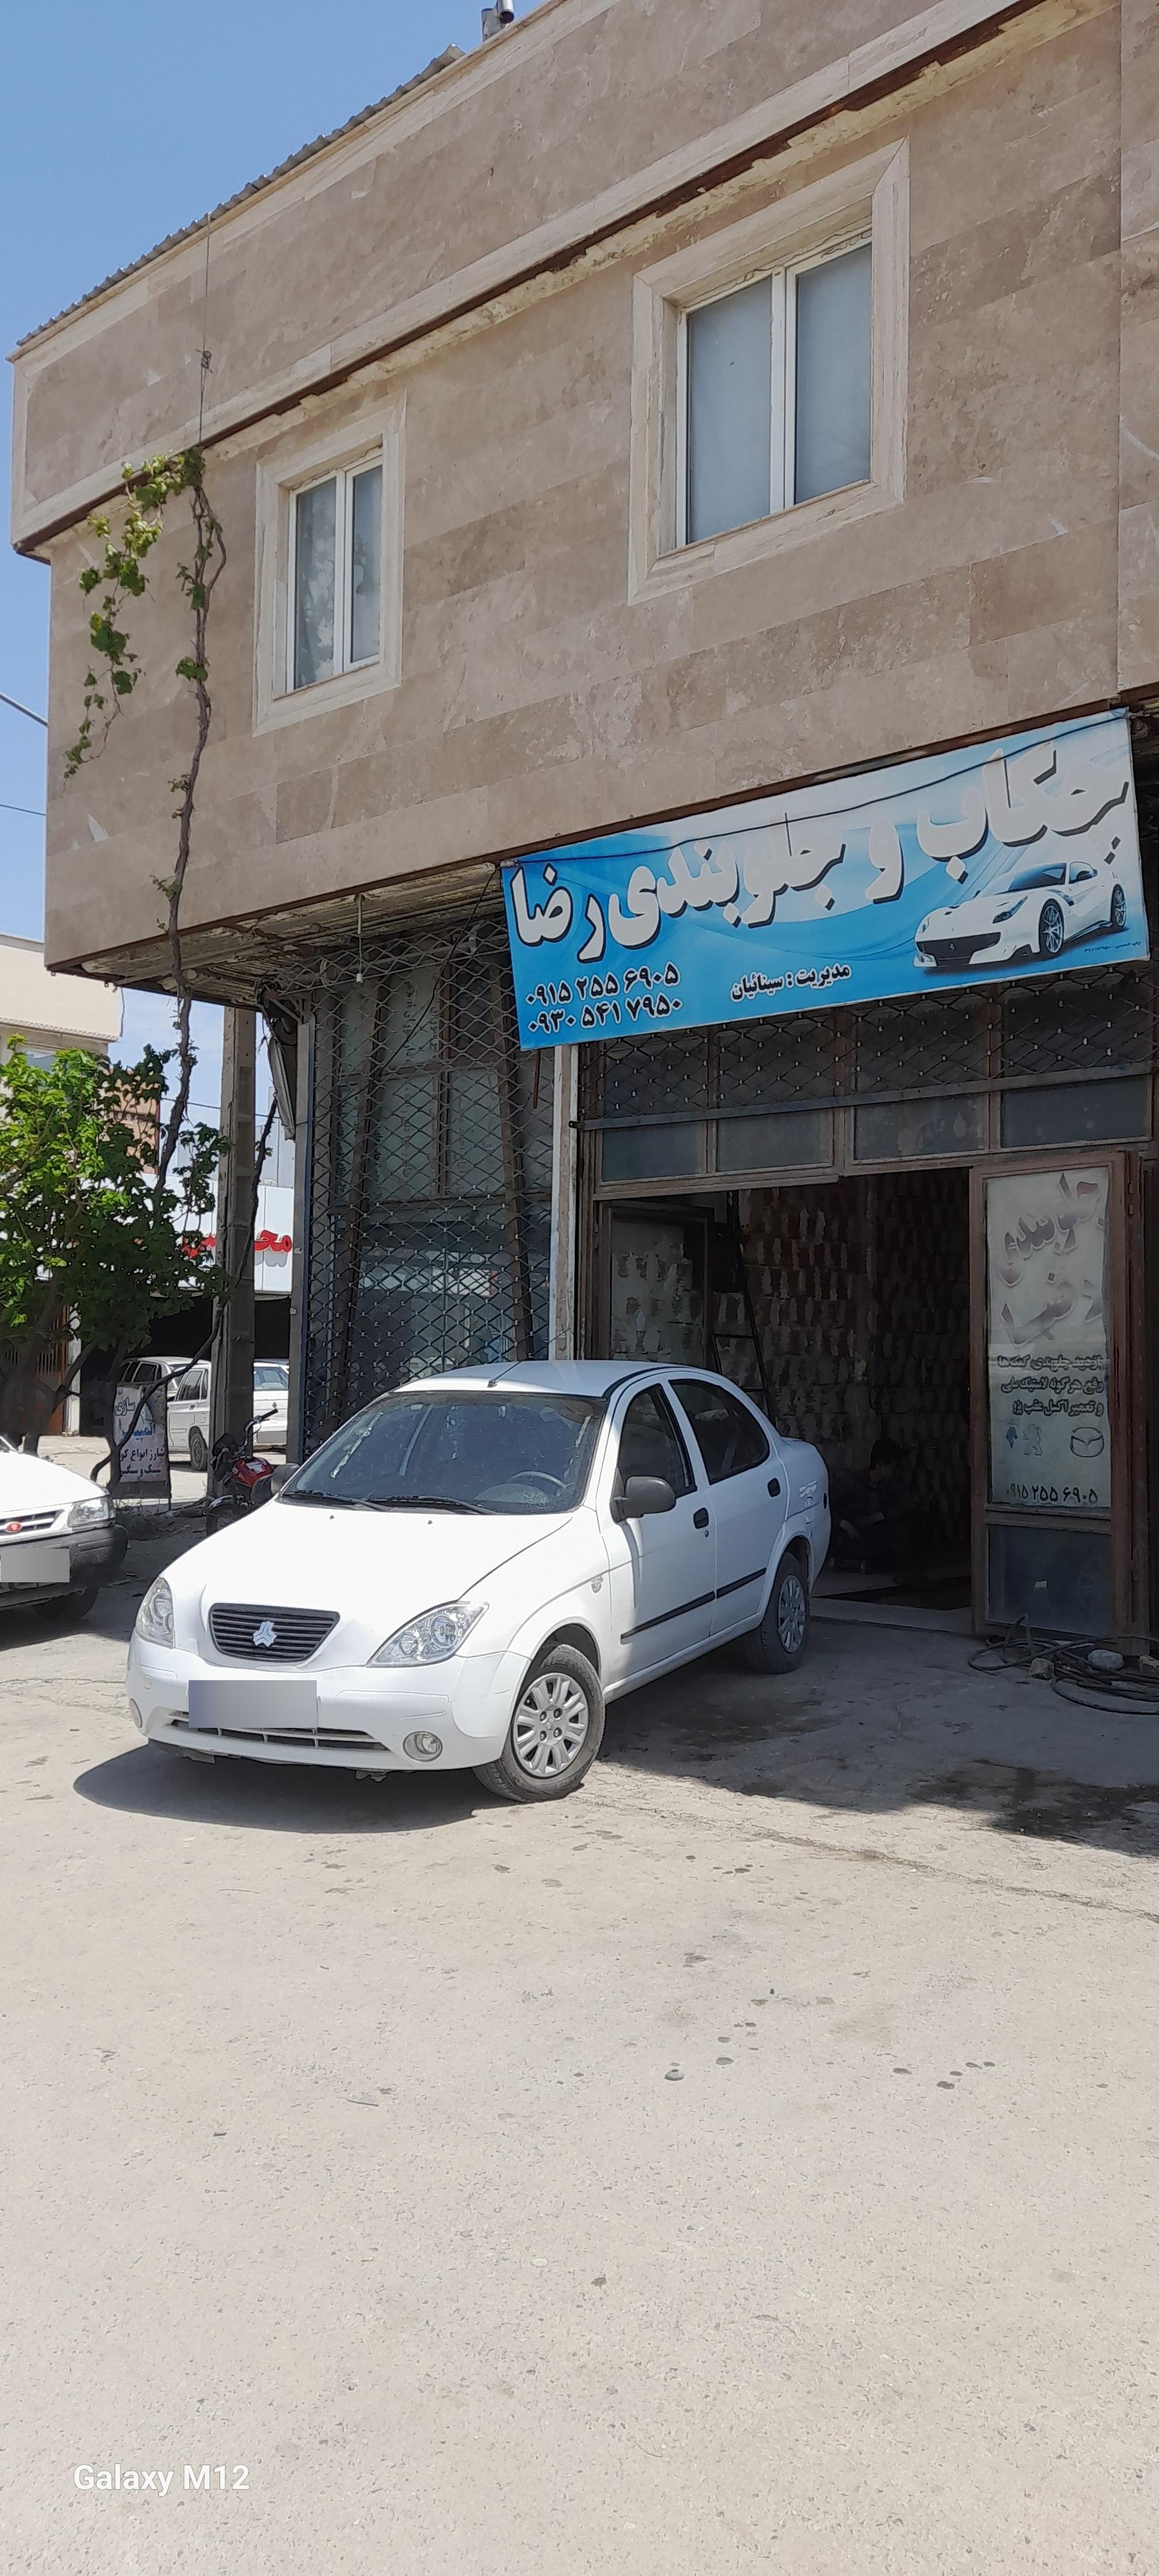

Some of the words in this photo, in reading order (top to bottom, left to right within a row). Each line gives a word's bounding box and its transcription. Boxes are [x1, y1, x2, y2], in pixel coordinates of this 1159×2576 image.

[608, 811, 846, 949] جلوبندی
[867, 820, 903, 903] و
[511, 863, 606, 963] رضا
[526, 980, 572, 1006] ۰۹۱۵
[574, 972, 618, 1001] ۲۵۵
[623, 961, 681, 994] ۶۹۰۵
[795, 963, 851, 989] مدیریت
[528, 1009, 576, 1034] ۰۹۳۰
[581, 999, 621, 1028] ۵۴۱
[625, 992, 683, 1021] ۷۹۵۰
